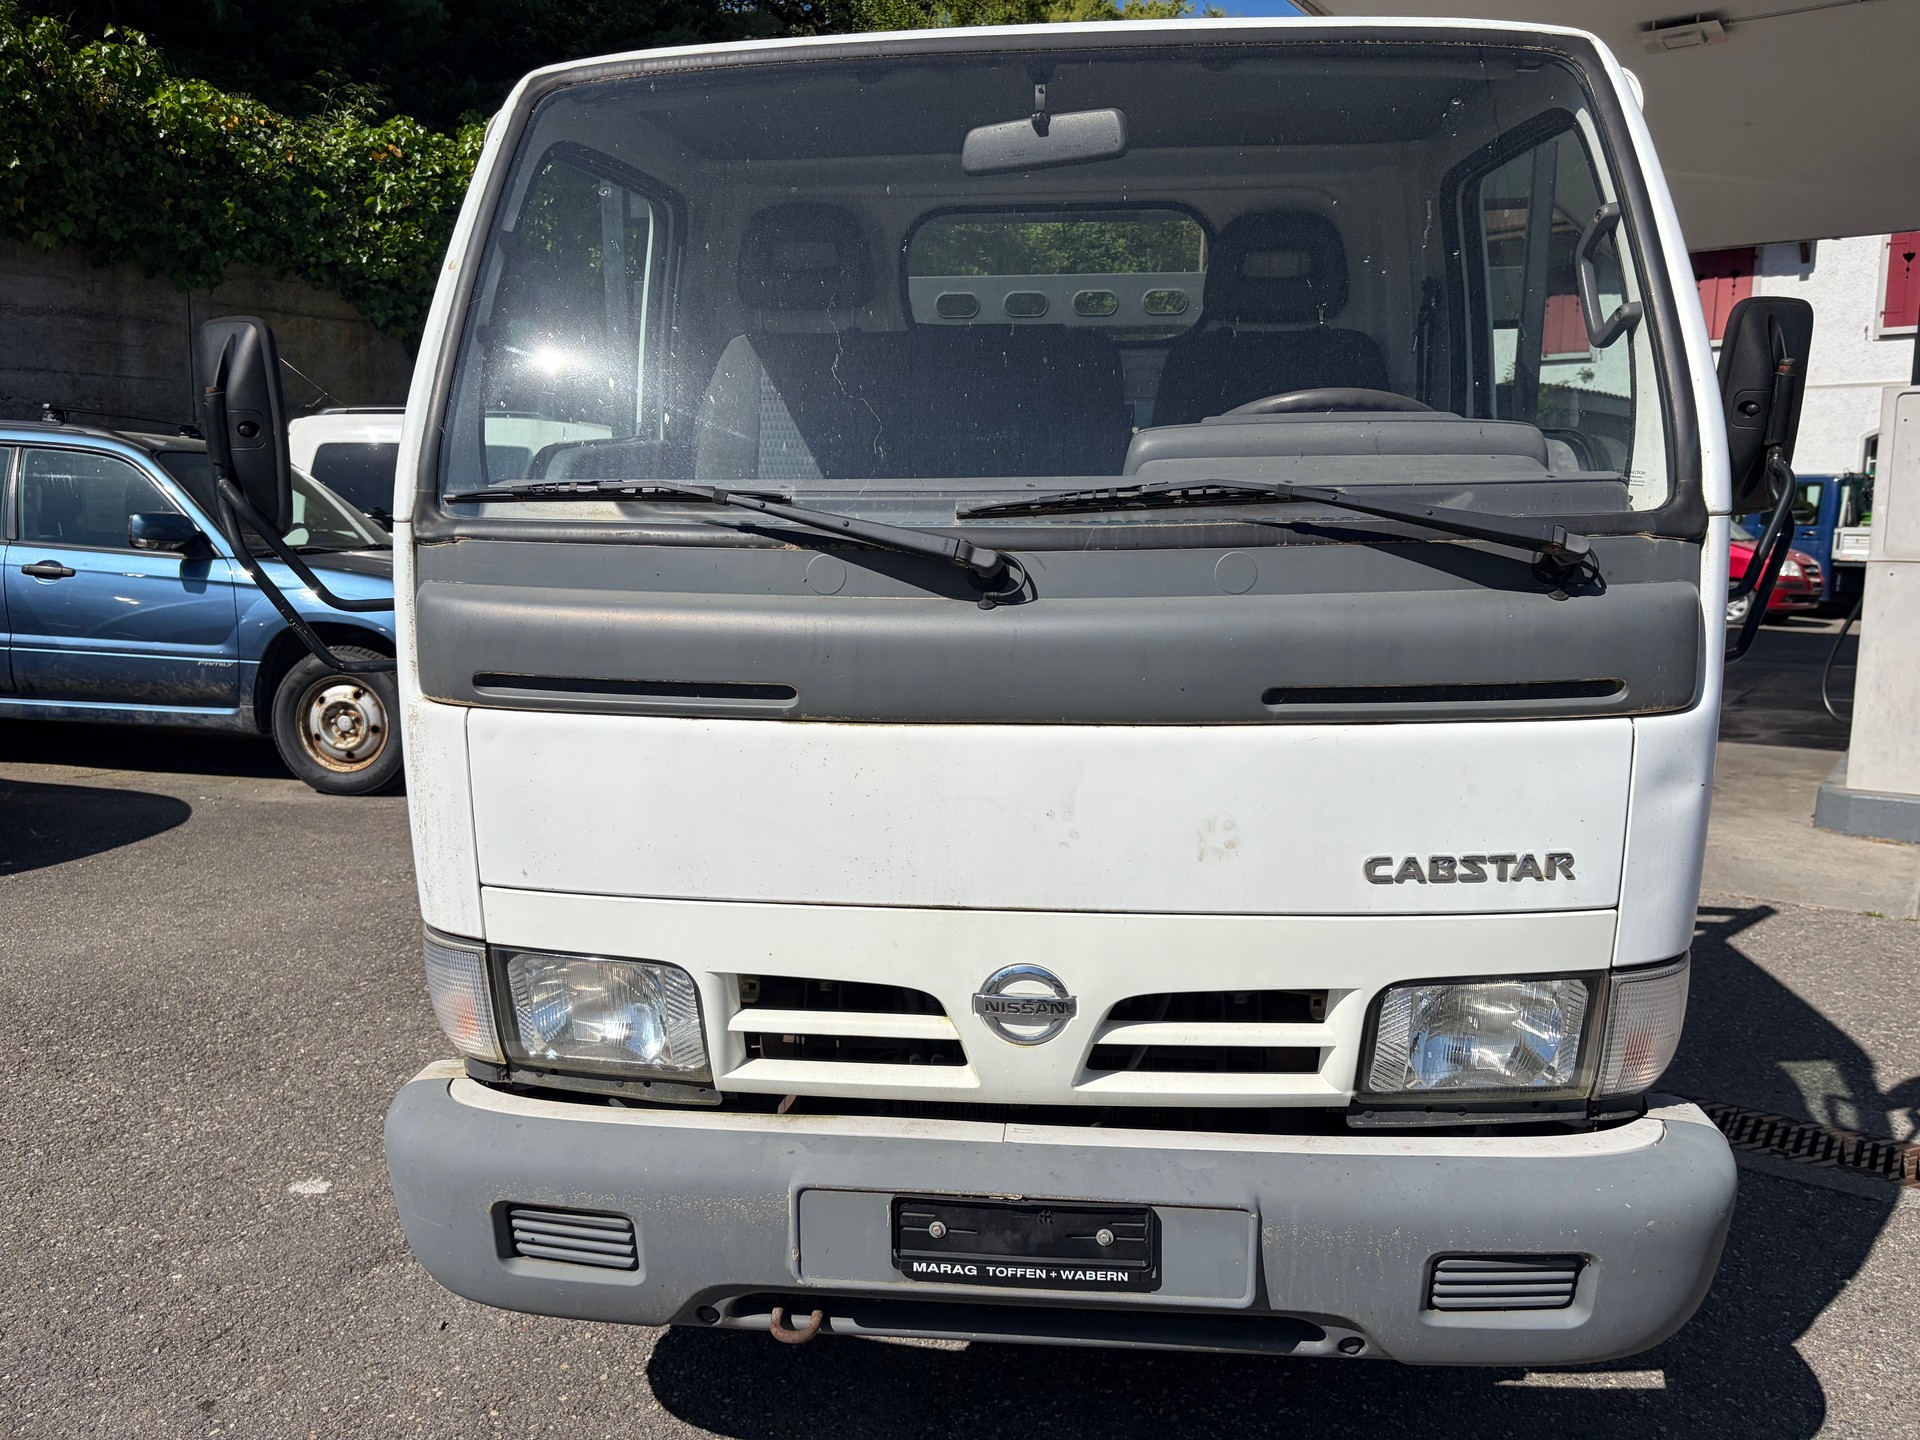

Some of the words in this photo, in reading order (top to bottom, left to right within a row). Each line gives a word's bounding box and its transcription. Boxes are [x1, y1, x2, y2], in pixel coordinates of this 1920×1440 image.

[1363, 852, 1577, 885] CABSTAR
[985, 1001, 1066, 1015] NISSAN
[913, 1262, 978, 1276] MARAG
[986, 1266, 1047, 1280] TOFFEN
[1060, 1269, 1129, 1282] WABERN
